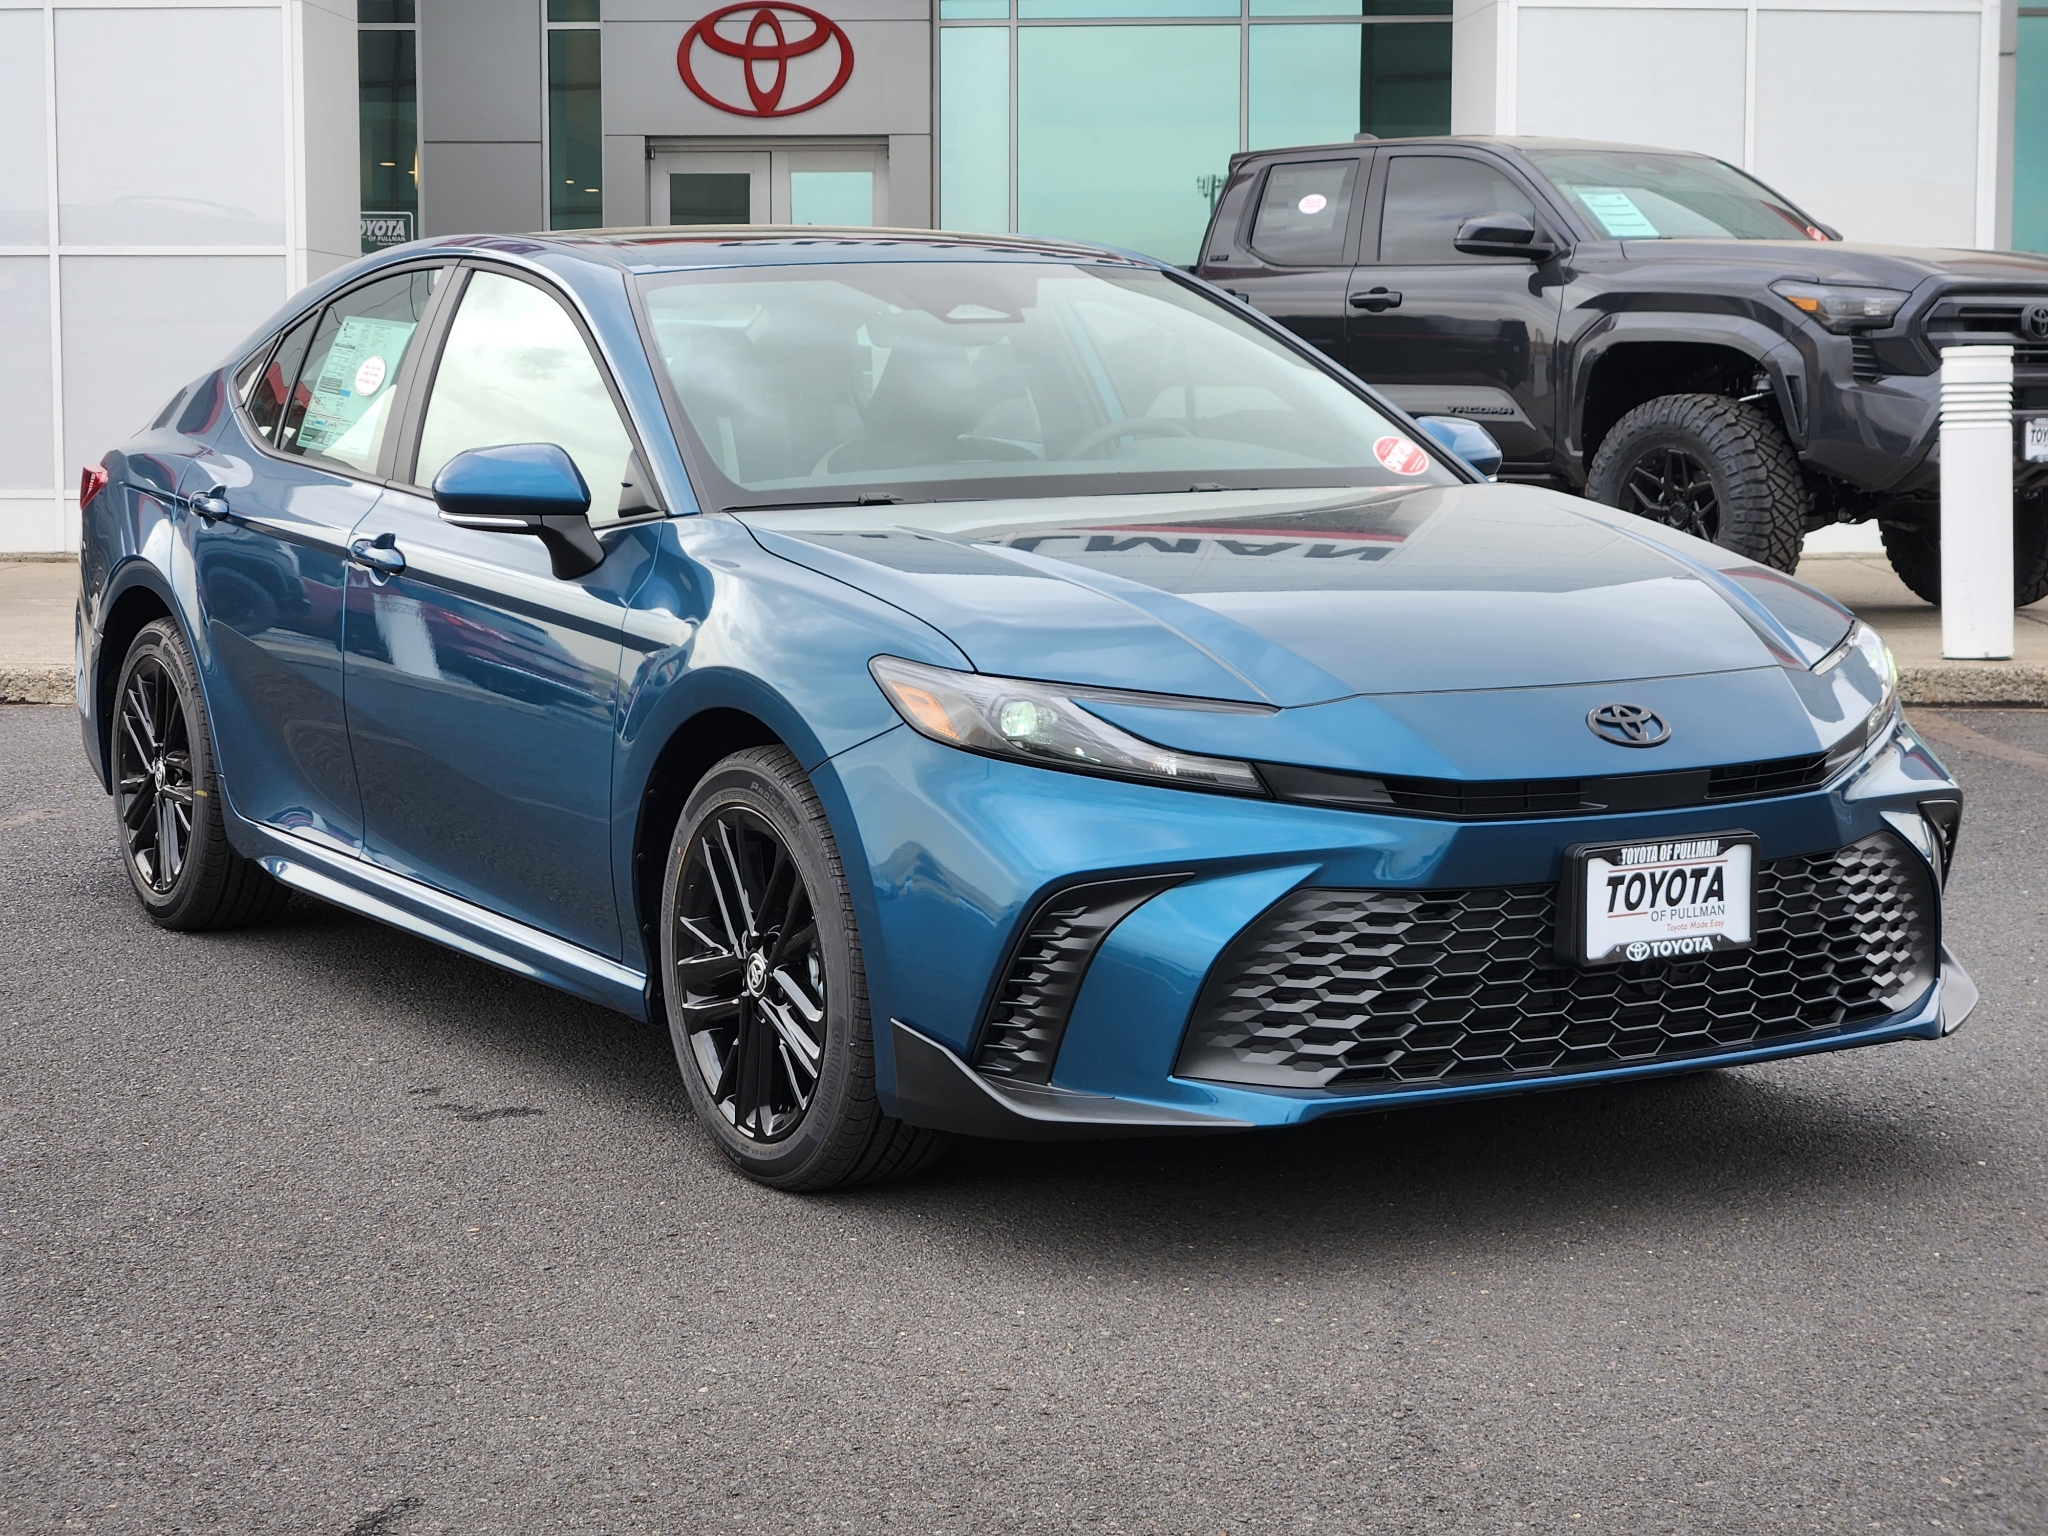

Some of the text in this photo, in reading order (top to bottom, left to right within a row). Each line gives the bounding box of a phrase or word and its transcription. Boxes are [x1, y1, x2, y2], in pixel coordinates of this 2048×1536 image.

[1621, 840, 1719, 865] TOYOTA OF PULLMAN
[1606, 866, 1724, 913] TOYOTA
[1651, 904, 1725, 922] OF PULLMAN
[1667, 919, 1725, 933] Toyota Made Easy
[1650, 936, 1714, 957] TOYOTA
